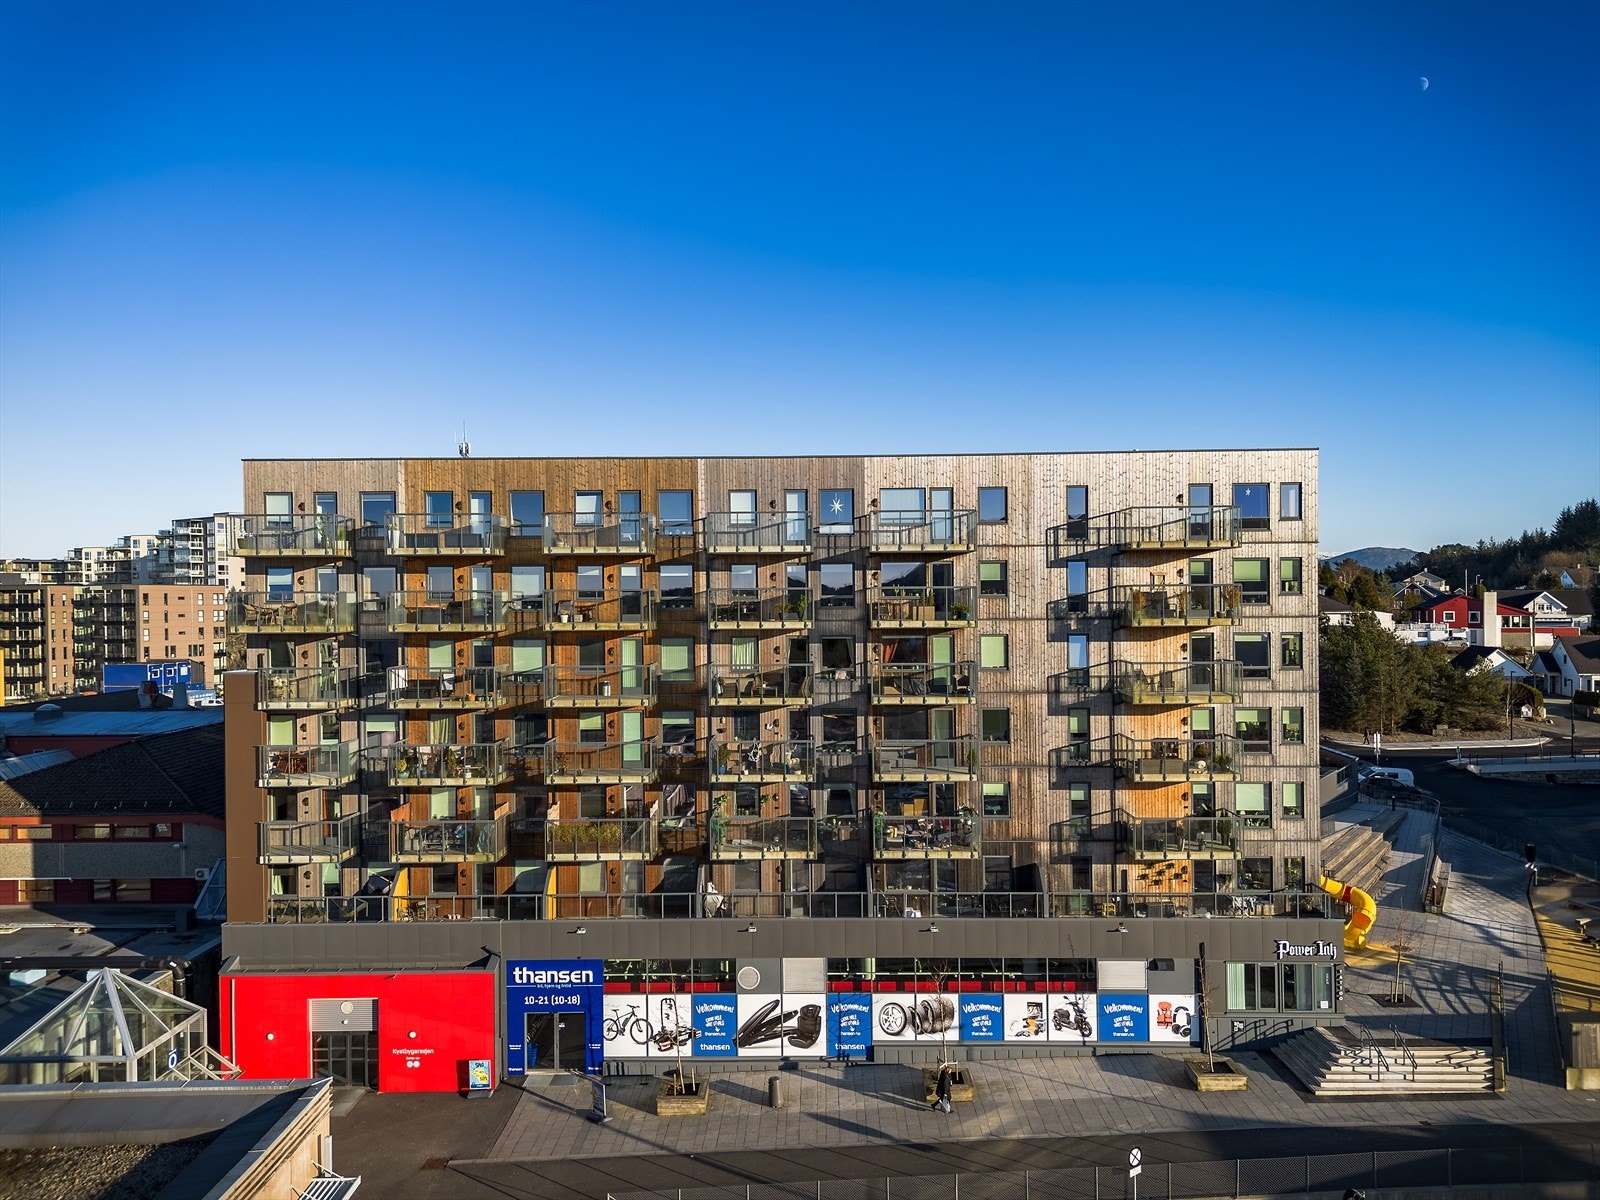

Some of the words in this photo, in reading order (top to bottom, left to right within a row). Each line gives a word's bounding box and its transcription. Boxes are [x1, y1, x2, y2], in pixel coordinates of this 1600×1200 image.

[1276, 940, 1315, 960] Power
[1316, 940, 1337, 960] Ink
[512, 966, 593, 984] thansen
[524, 995, 549, 1005] 10-21
[551, 994, 581, 1006] (10-18)
[695, 1003, 734, 1014] Velkommen!
[962, 1003, 1001, 1013] Velkommen!
[1103, 1003, 1144, 1014] Velkommen!
[699, 1043, 731, 1051] thansen
